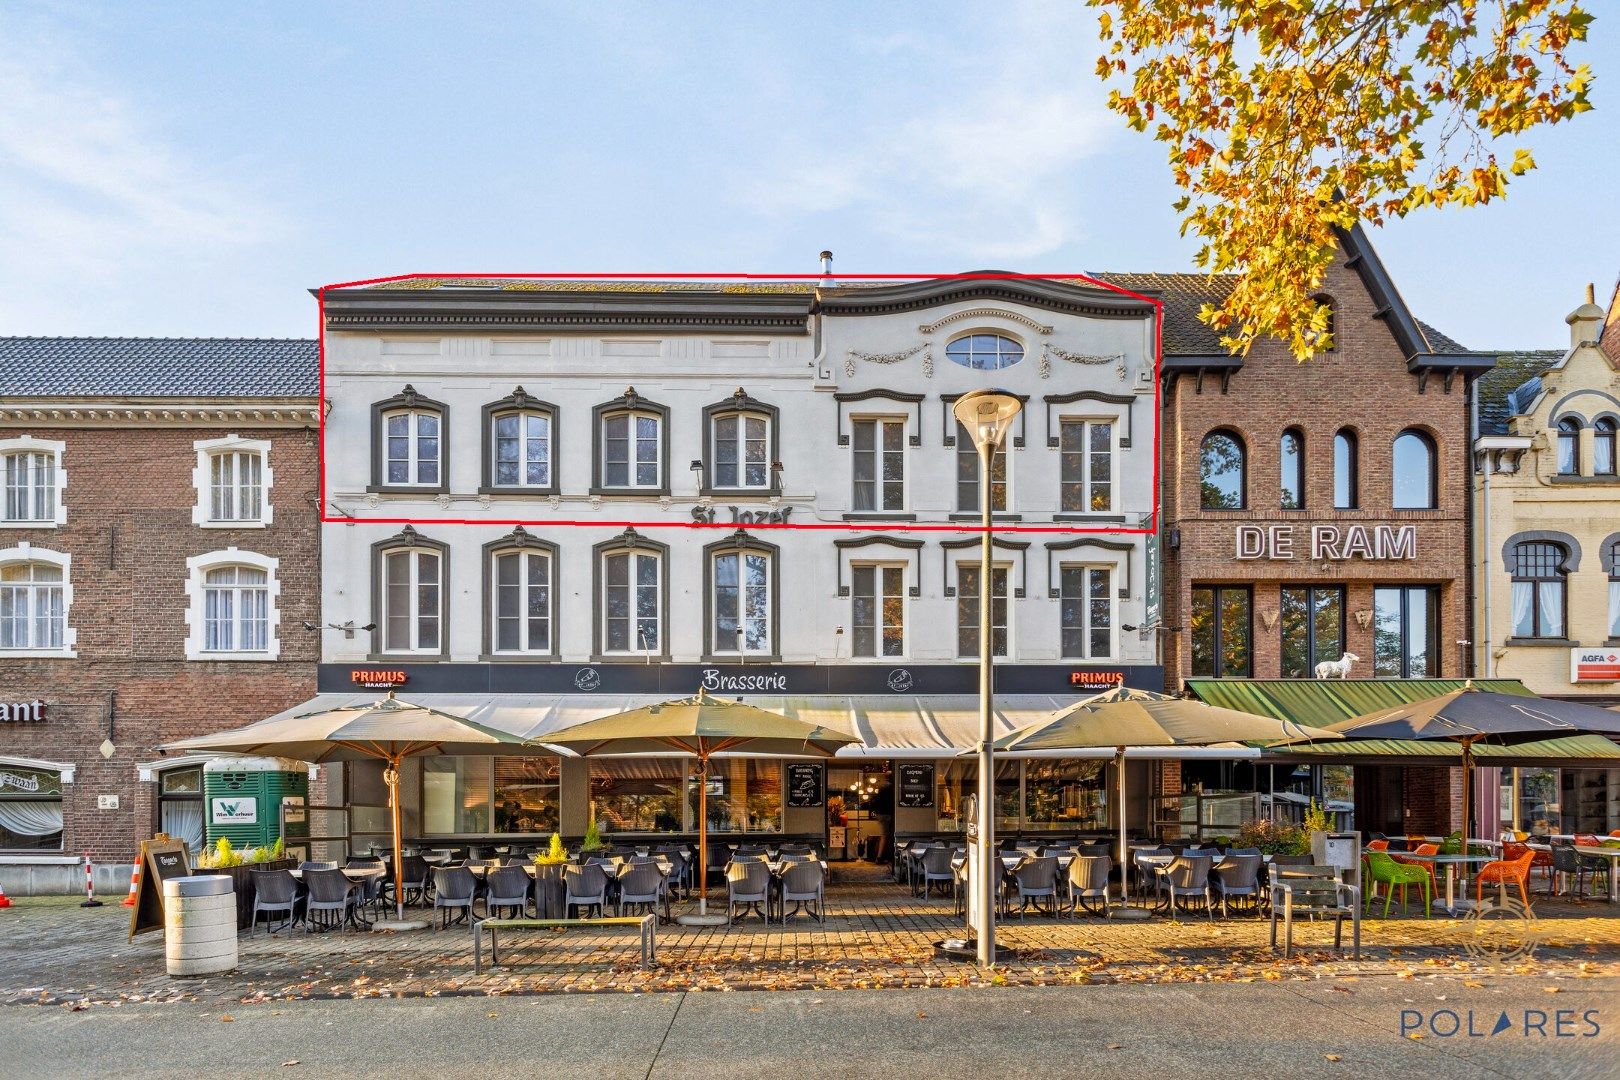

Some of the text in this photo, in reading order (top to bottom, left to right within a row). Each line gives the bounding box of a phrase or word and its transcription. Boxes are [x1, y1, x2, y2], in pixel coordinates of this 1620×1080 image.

[1236, 525, 1417, 560] DE RAM
[1581, 654, 1605, 663] AGFA
[351, 671, 406, 682] PRIMUS
[701, 669, 786, 690] Brasserie
[1072, 672, 1123, 683] PRIMUS
